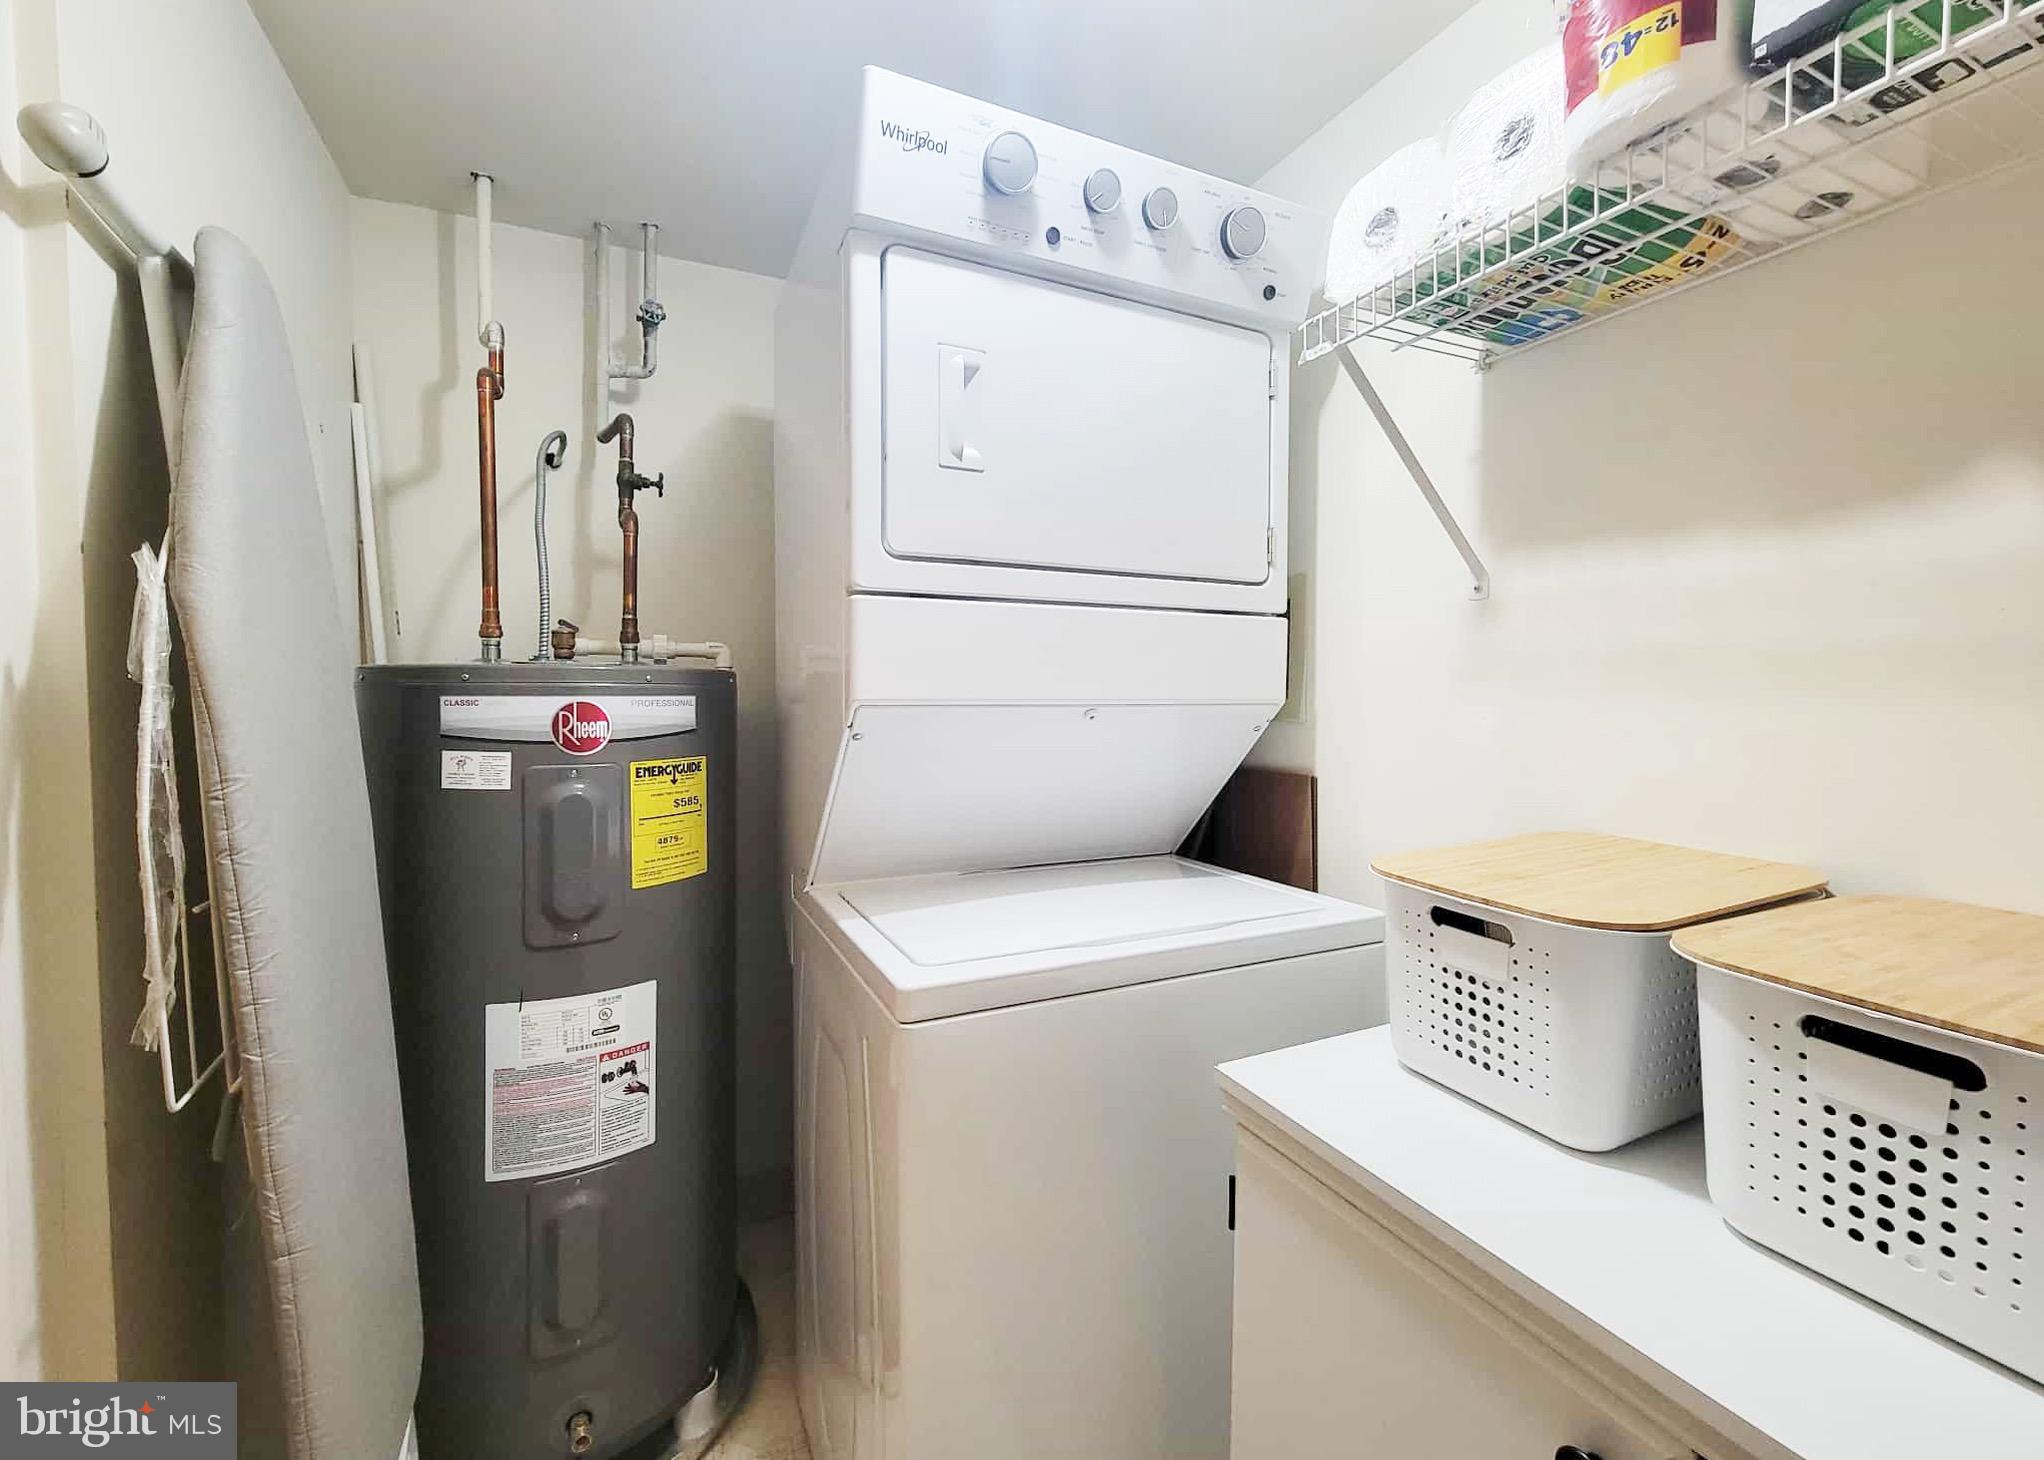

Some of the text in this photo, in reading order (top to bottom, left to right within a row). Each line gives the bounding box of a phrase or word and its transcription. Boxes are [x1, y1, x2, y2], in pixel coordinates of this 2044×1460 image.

[880, 119, 948, 155] Whirlpool
[443, 699, 480, 707] CLASSIC
[631, 699, 695, 708] PROFESSIONAL
[558, 702, 608, 746] Rheem
[612, 1043, 648, 1059] DANGER
